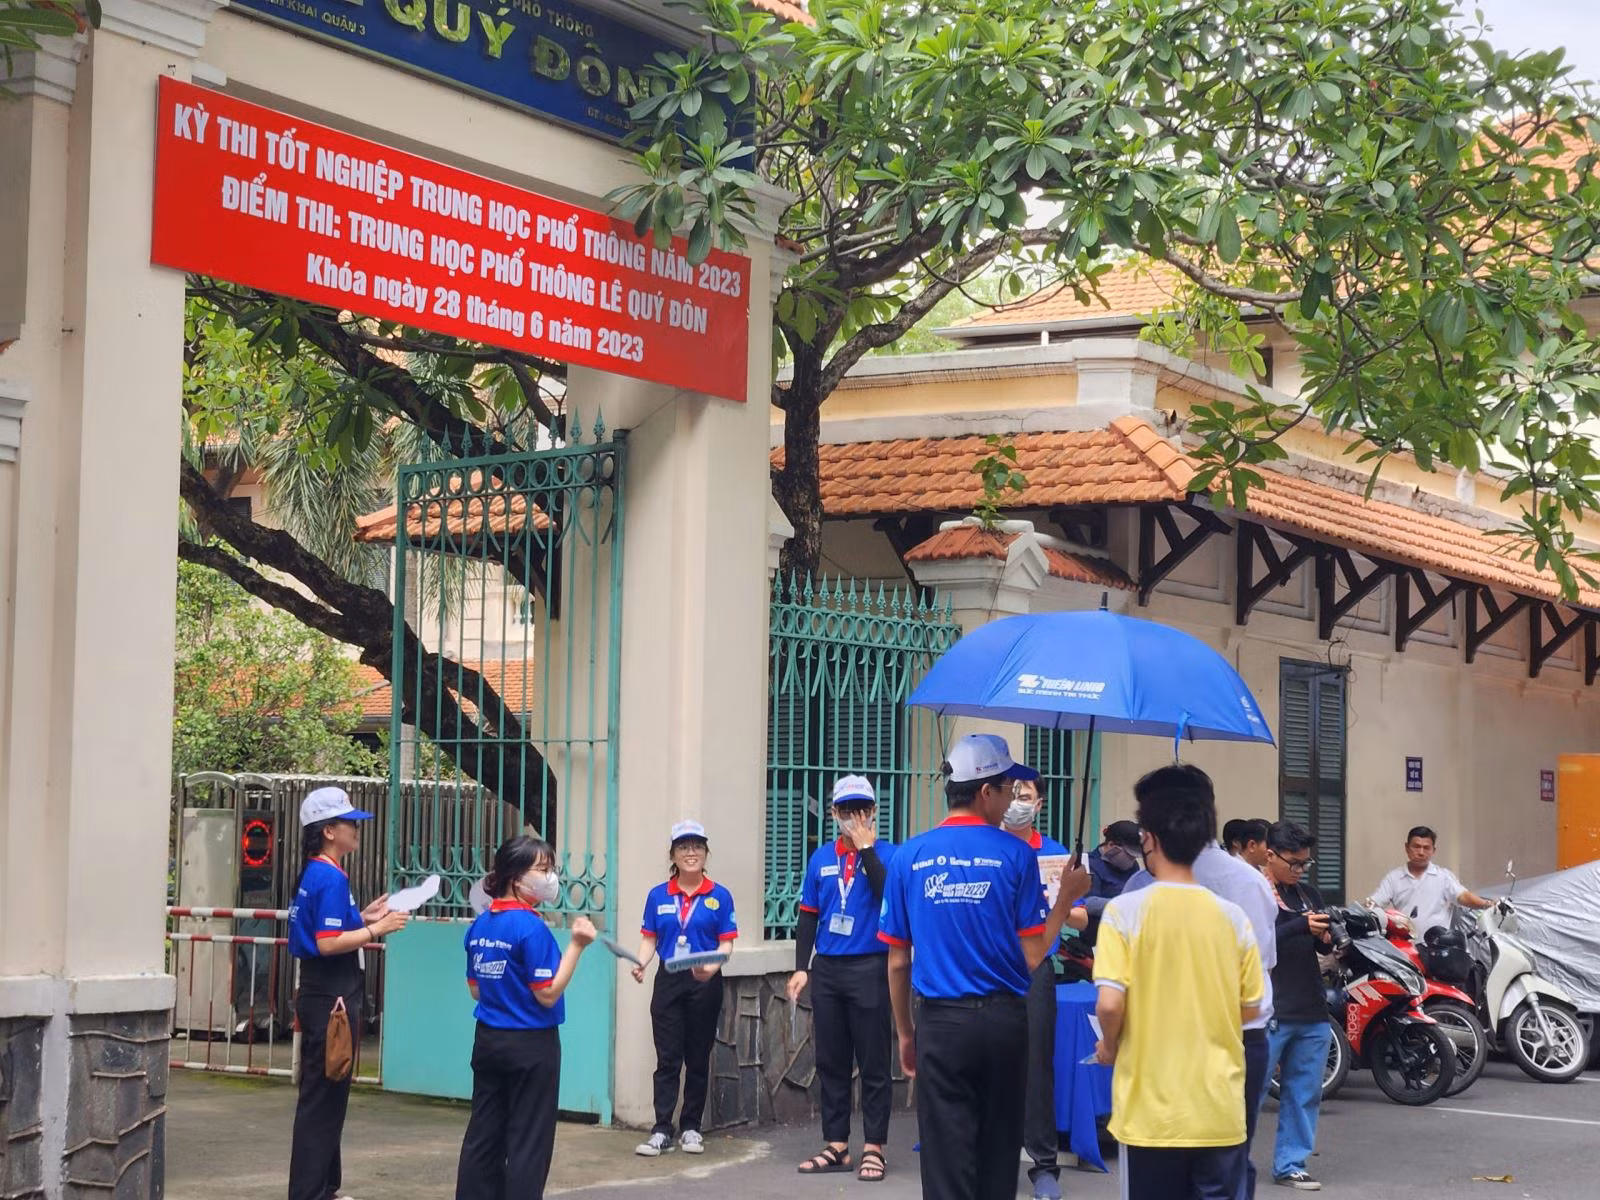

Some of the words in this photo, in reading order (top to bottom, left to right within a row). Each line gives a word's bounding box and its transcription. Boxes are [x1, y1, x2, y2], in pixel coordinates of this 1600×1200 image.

[287, 0, 317, 17] KHAI
[322, 11, 357, 33] QUẬN
[359, 24, 366, 35] 3
[384, 0, 515, 59] QUÝ
[533, 35, 651, 106] ĐÔN
[547, 8, 594, 38] THÔNG
[174, 103, 209, 143] KỲ
[217, 116, 257, 159] THI
[265, 127, 309, 173] TỐT
[316, 147, 403, 204] NGHIỆP
[410, 176, 482, 225] TRUNG
[489, 200, 530, 241] HỌC
[536, 214, 579, 252] PHỔ
[583, 228, 645, 271] THÔNG
[651, 248, 693, 285] NĂM
[699, 263, 741, 297] 2023
[222, 173, 288, 224] ĐIỂM
[296, 196, 341, 238] THI:
[348, 211, 424, 262] TRUNG
[430, 234, 474, 276] HỌC
[480, 247, 525, 287] PHỔ
[529, 261, 595, 306] THÔNG
[600, 280, 622, 313] LÊ
[628, 289, 664, 323] QUÝ
[669, 299, 707, 335] ĐÔN
[307, 252, 366, 296] Khóa
[374, 275, 428, 313] ngày
[433, 287, 460, 319] 28
[467, 295, 525, 337] tháng
[530, 311, 543, 338] 6
[549, 316, 591, 350] năm
[597, 327, 644, 362] 2023
[1347, 1003, 1361, 1041] beats
